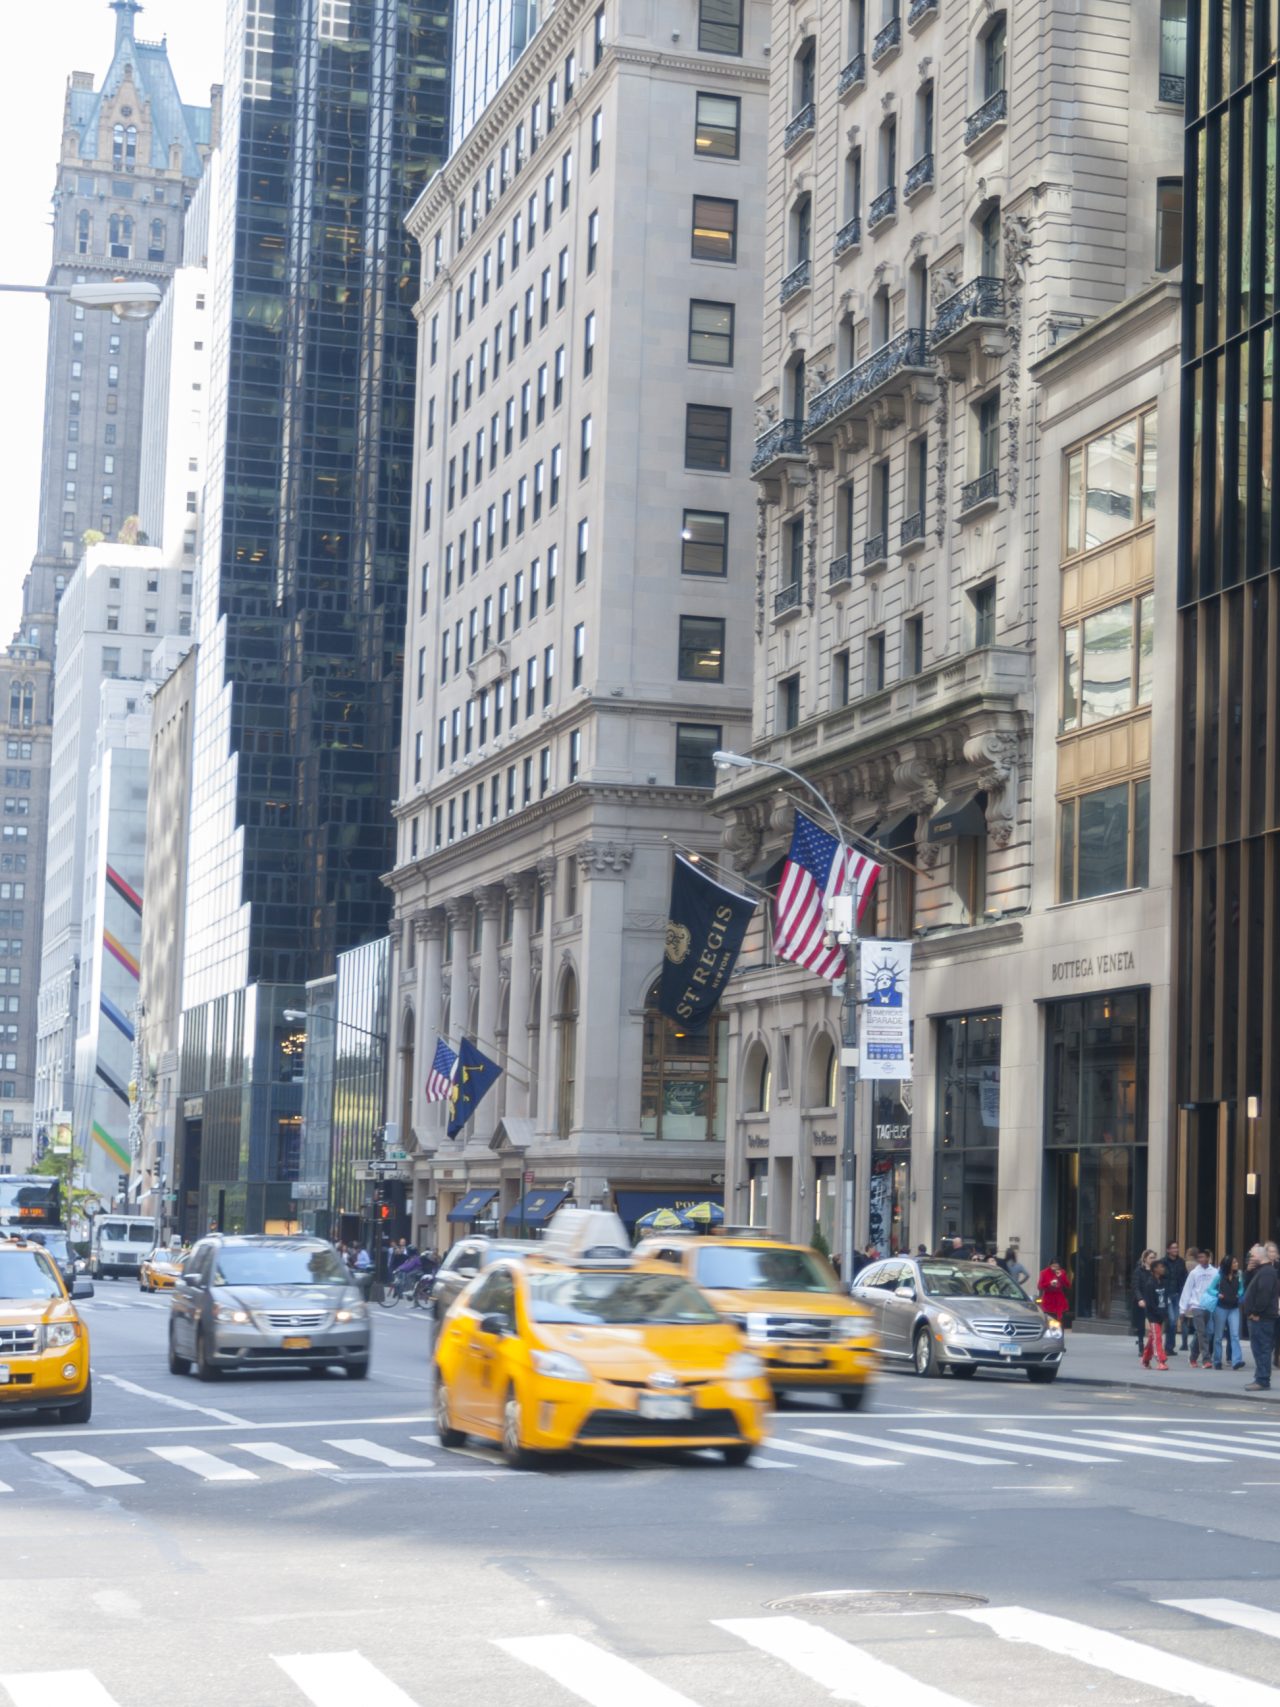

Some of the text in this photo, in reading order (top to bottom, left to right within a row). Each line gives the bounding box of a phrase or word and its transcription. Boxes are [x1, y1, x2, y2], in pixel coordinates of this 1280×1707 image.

[693, 905, 733, 986] REGIS
[1051, 951, 1135, 981] BOTTEGA VENETA
